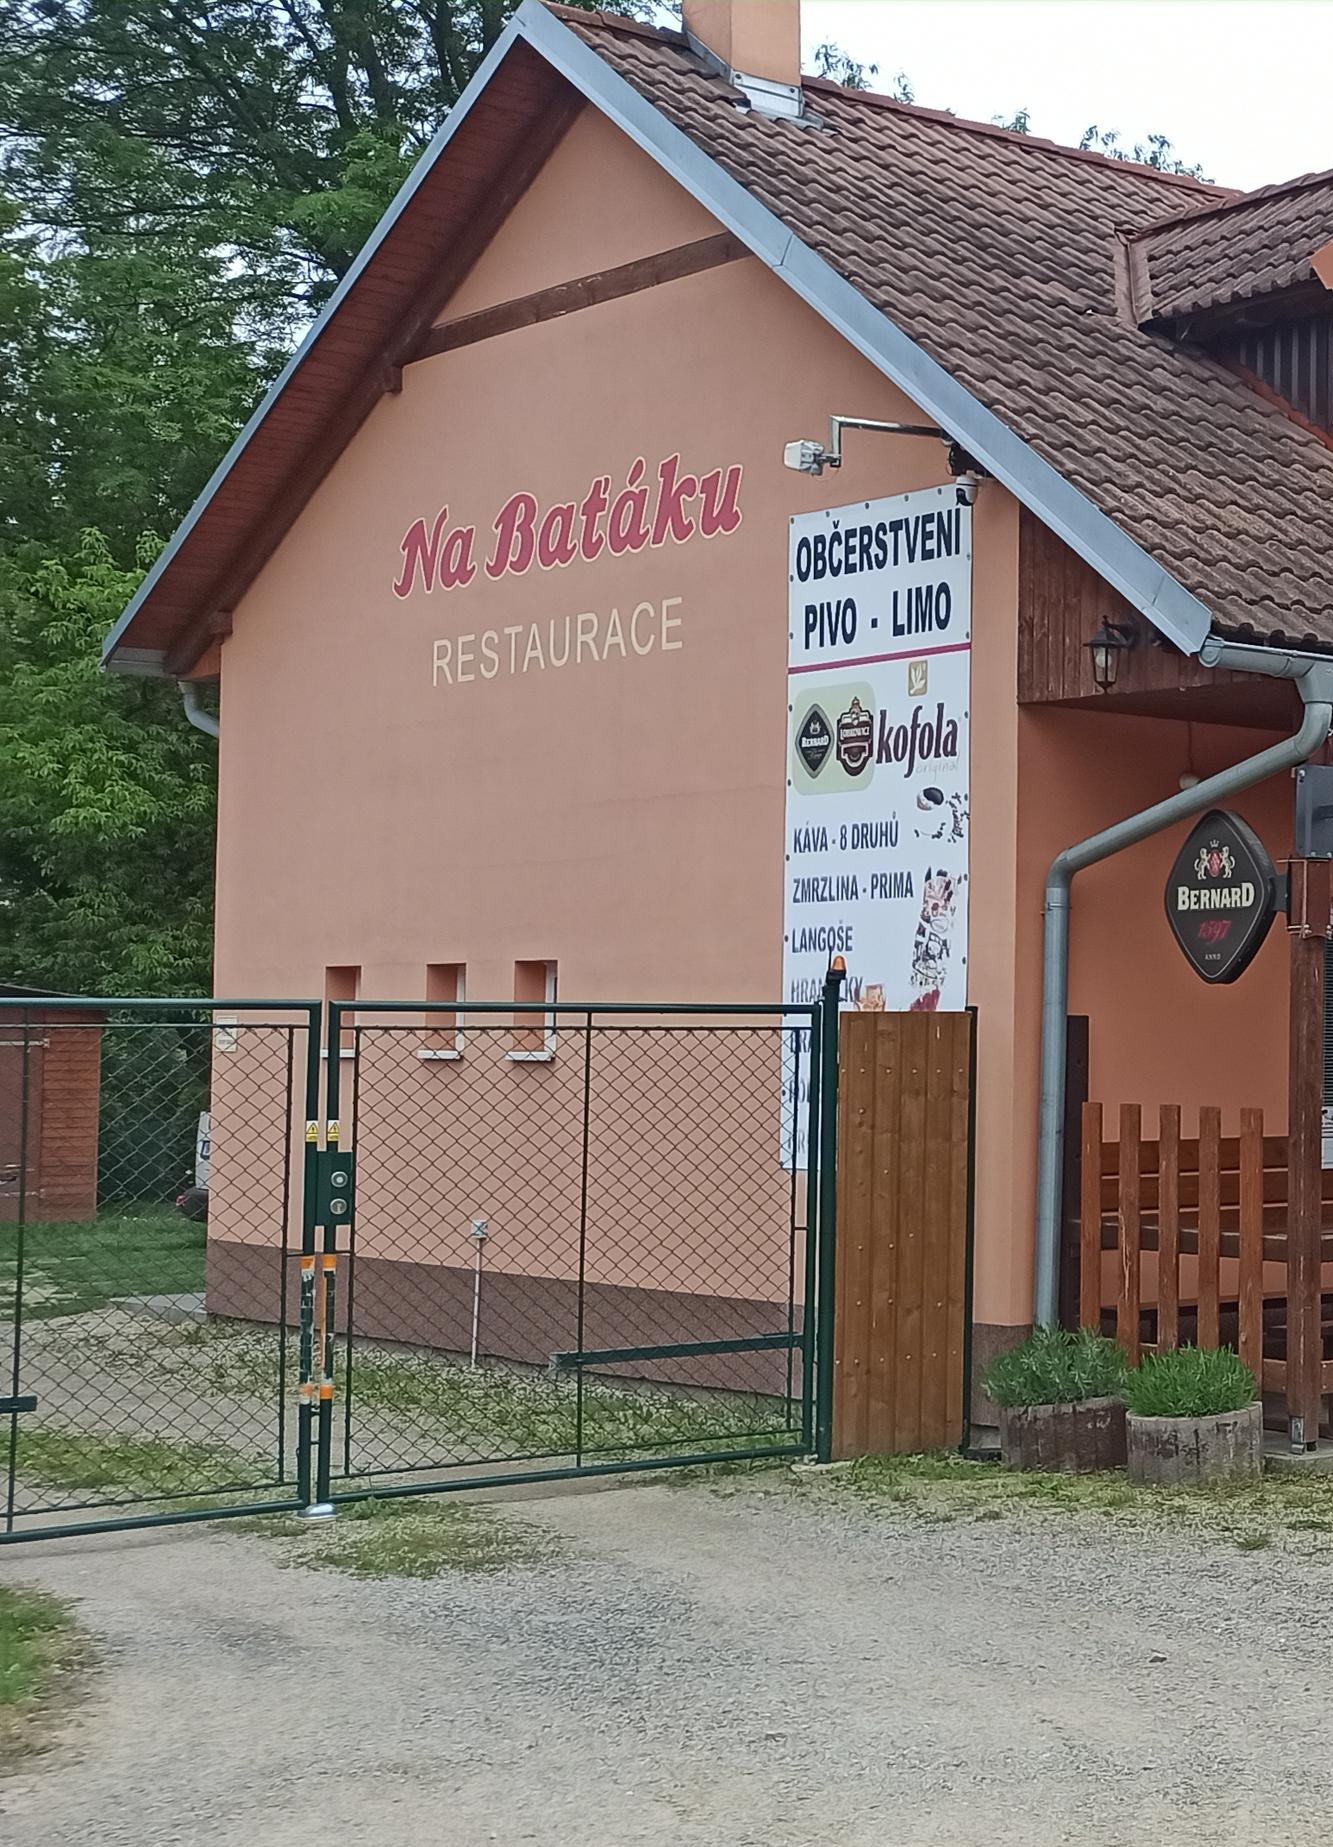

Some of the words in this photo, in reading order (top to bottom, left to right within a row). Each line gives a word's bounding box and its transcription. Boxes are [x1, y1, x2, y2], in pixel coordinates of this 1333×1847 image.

[393, 506, 477, 599] Na
[484, 452, 744, 581] Baťáku
[796, 503, 961, 583] OBČERSTVENÍ
[432, 597, 684, 687] RESTAURACE
[804, 597, 857, 650] PIVO
[893, 581, 951, 637] LIMO
[876, 702, 959, 778] kofola
[793, 821, 828, 854] KÁVA
[840, 826, 848, 851] 8
[851, 811, 899, 850] DRUHŮ
[792, 873, 860, 904] ZMRZLINA
[870, 871, 914, 900] PRIMA
[1177, 883, 1255, 911] BERNARD
[791, 919, 853, 953] LANGOŠE
[791, 976, 863, 1003] HRAKY
